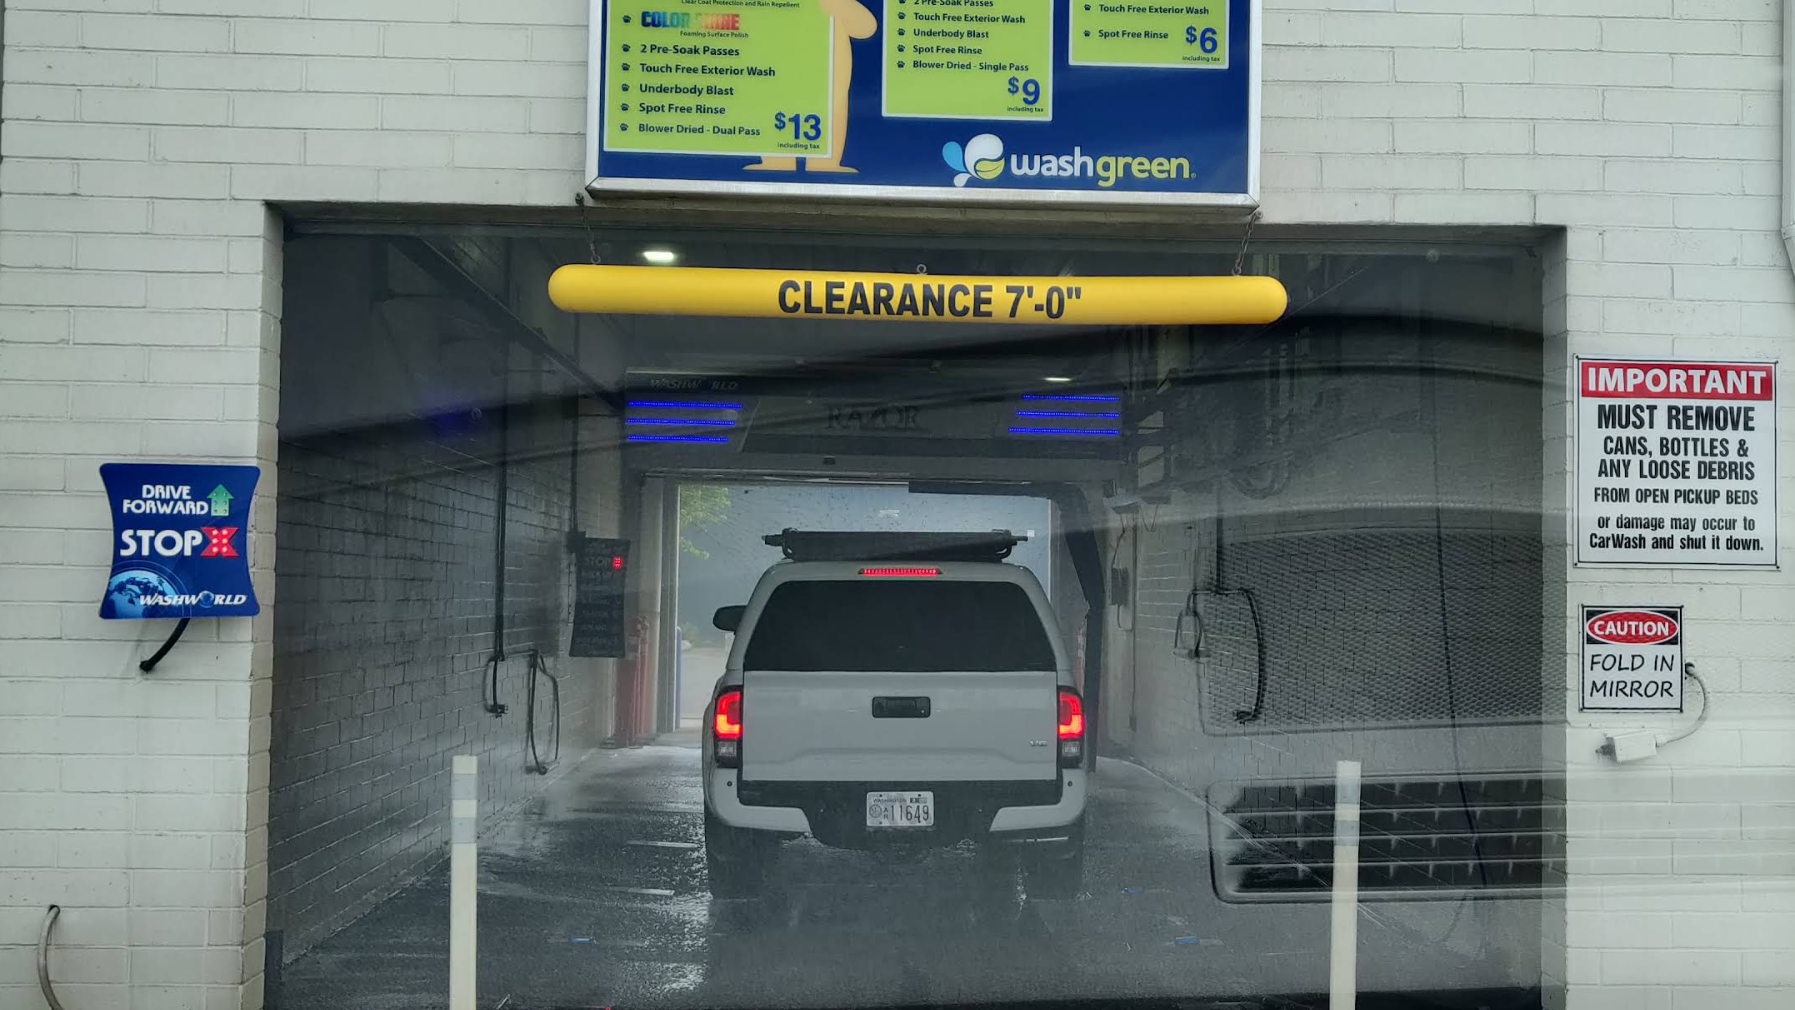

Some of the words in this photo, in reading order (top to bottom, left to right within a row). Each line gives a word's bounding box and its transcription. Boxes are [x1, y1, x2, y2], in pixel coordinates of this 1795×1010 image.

[1099, 4, 1125, 12] Touch
[1127, 5, 1147, 13] Free
[1148, 6, 1184, 14] Exterior
[1186, 6, 1209, 15] Wash
[641, 11, 690, 28] COLOR
[695, 12, 740, 31] HINE
[913, 12, 940, 21] Touch
[942, 13, 962, 22] Free
[964, 14, 1000, 23] Exterior
[1001, 15, 1026, 24] Wash
[680, 30, 706, 38] Foaming
[913, 28, 965, 39] Underbody
[966, 30, 989, 39] Blast
[1098, 29, 1120, 39] Spot
[1121, 30, 1142, 38] Free
[1144, 30, 1169, 39] Rinse
[1185, 25, 1218, 54] $6
[640, 44, 647, 53] 2
[650, 44, 700, 55] Pre-Soak
[702, 46, 740, 56] Passes
[913, 45, 934, 55] Spot
[936, 45, 956, 54] Free
[958, 46, 983, 55] Rinse
[640, 63, 673, 74] Touch
[675, 64, 699, 75] Free
[701, 65, 745, 76] Exterior
[746, 66, 776, 77] Wash
[913, 60, 945, 69] Blower
[947, 61, 972, 70] Dried
[979, 62, 1007, 73] Single
[1009, 63, 1029, 71] Pass
[639, 83, 703, 97] Underbody
[706, 84, 735, 96] Blast
[1007, 76, 1041, 106] $9
[638, 102, 666, 115] Spot
[667, 103, 693, 114] Free
[695, 104, 726, 115] Rinse
[638, 123, 674, 134] Blower
[676, 124, 704, 135] Dried
[712, 125, 737, 135] Dual
[739, 126, 761, 136] Pass
[774, 111, 822, 141] $13
[777, 142, 807, 150] including
[778, 280, 993, 318] CLEARANCE
[1005, 285, 1082, 319] 7'-0"
[649, 378, 738, 390] WASHWRLD
[1588, 367, 1767, 394] IMPORTANT
[1597, 404, 1658, 430] MUST
[1667, 405, 1755, 432] REMOVE
[1603, 436, 1653, 458] CANS,
[1659, 437, 1730, 458] BOTTLES
[1737, 439, 1749, 458] &
[1597, 459, 1632, 478] ANY
[1639, 460, 1691, 480] LOOSE
[1697, 461, 1755, 481] DEBRIS
[142, 484, 191, 500] DRIVE
[1594, 487, 1630, 503] FROM
[1635, 488, 1669, 504] OPEN
[1674, 489, 1720, 505] PICKUP
[1726, 490, 1758, 506] BEDS
[122, 500, 209, 515] FORWARD
[1597, 515, 1611, 529] or
[1616, 514, 1665, 531] damage
[1670, 516, 1696, 532] may
[1702, 517, 1738, 531] occur
[1743, 516, 1756, 531] to
[120, 529, 203, 557] STOP
[1589, 533, 1646, 549] CarWash
[1651, 534, 1674, 550] and
[1679, 535, 1706, 550] shut
[1711, 535, 1720, 550] it
[1725, 536, 1764, 551] down.
[1593, 621, 1669, 636] CAUTION
[1590, 654, 1645, 671] FOLD
[1654, 654, 1675, 672] IN
[1590, 680, 1674, 698] MIRROR
[891, 804, 930, 823] 11649
